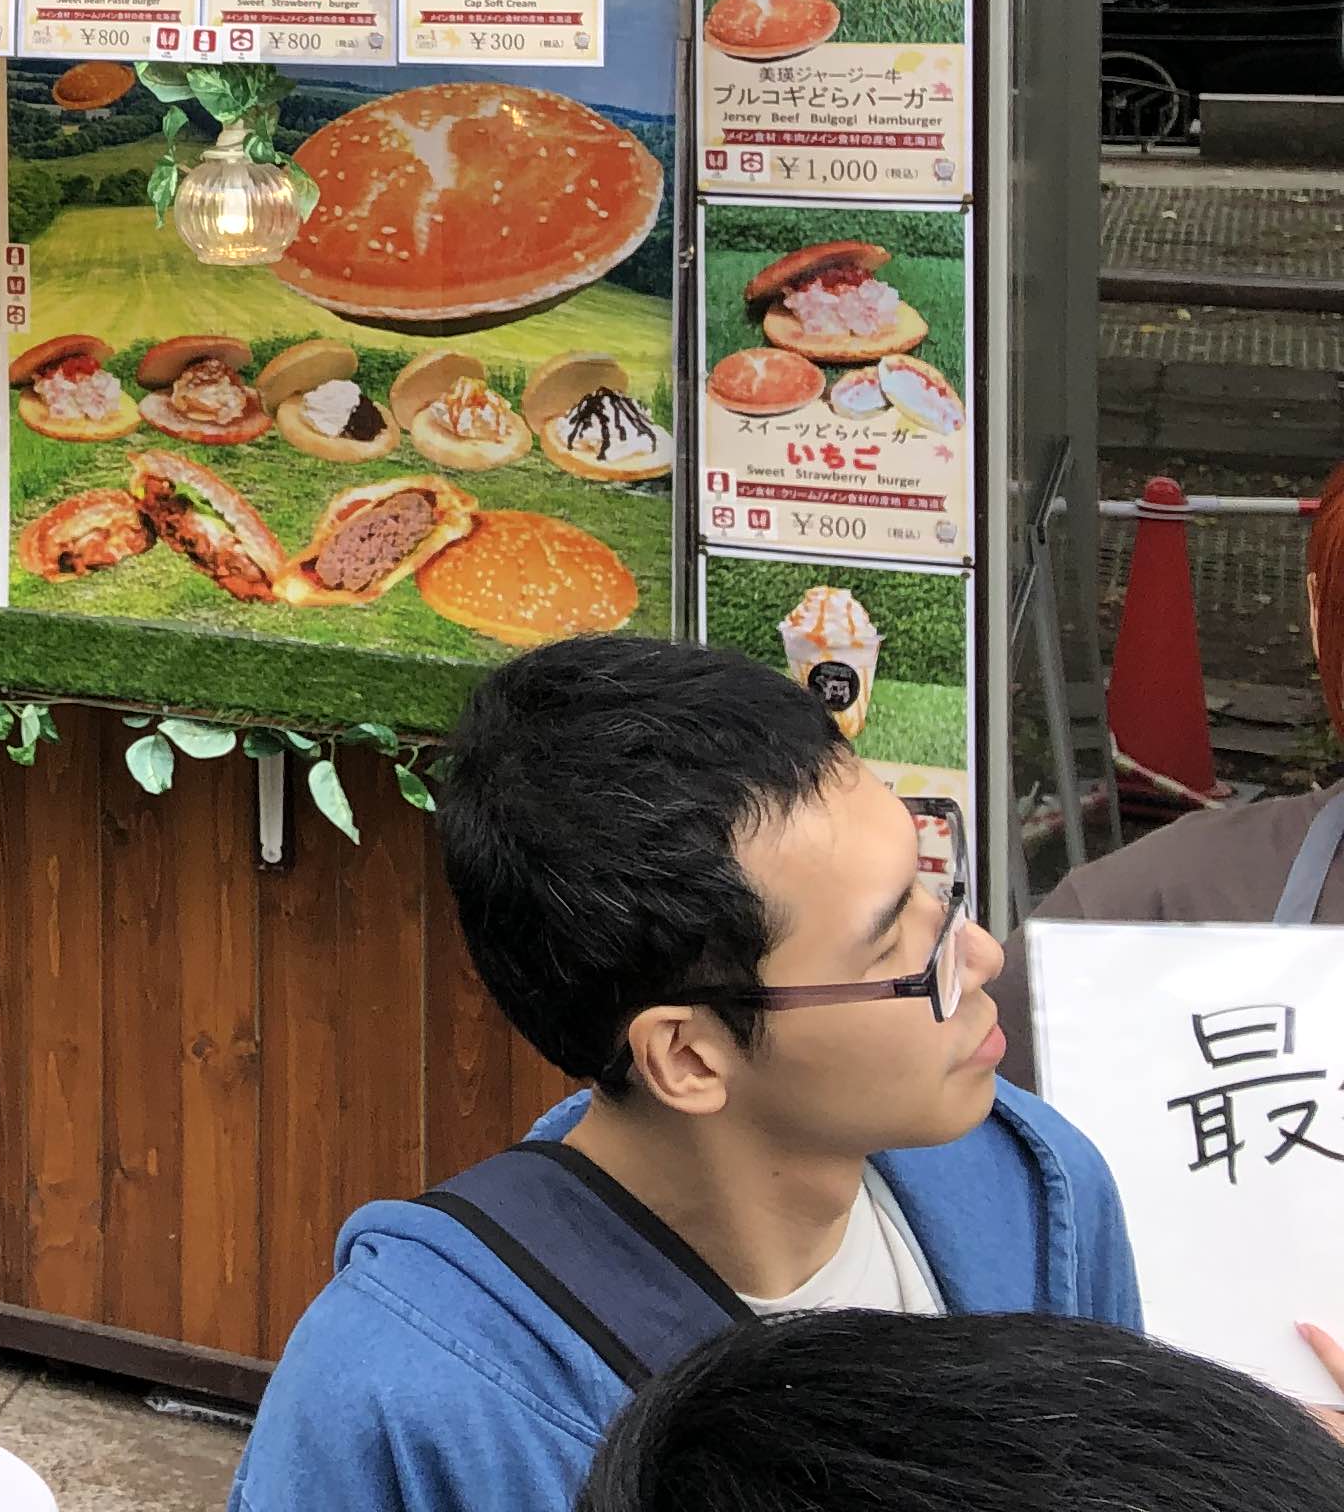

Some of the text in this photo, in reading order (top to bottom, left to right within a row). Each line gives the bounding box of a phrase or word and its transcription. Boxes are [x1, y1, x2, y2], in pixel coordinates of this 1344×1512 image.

[328, 0, 360, 10] burger
[81, 28, 130, 46] ¥800
[268, 30, 322, 50] ¥800
[470, 31, 526, 51] ¥300
[759, 67, 902, 85] 美瑛ジャージー牛
[713, 86, 954, 110] ブルコギどらバーガー
[722, 112, 943, 128] Jersey Beef Bulgogi Hamburger
[776, 155, 878, 183] ¥1,000
[737, 419, 928, 444] スイーツどらバーガー
[786, 442, 881, 471] いちご
[747, 464, 921, 488] Sweet Strawberry burger
[792, 511, 867, 540] ¥800
[1167, 1003, 1344, 1186] 最
